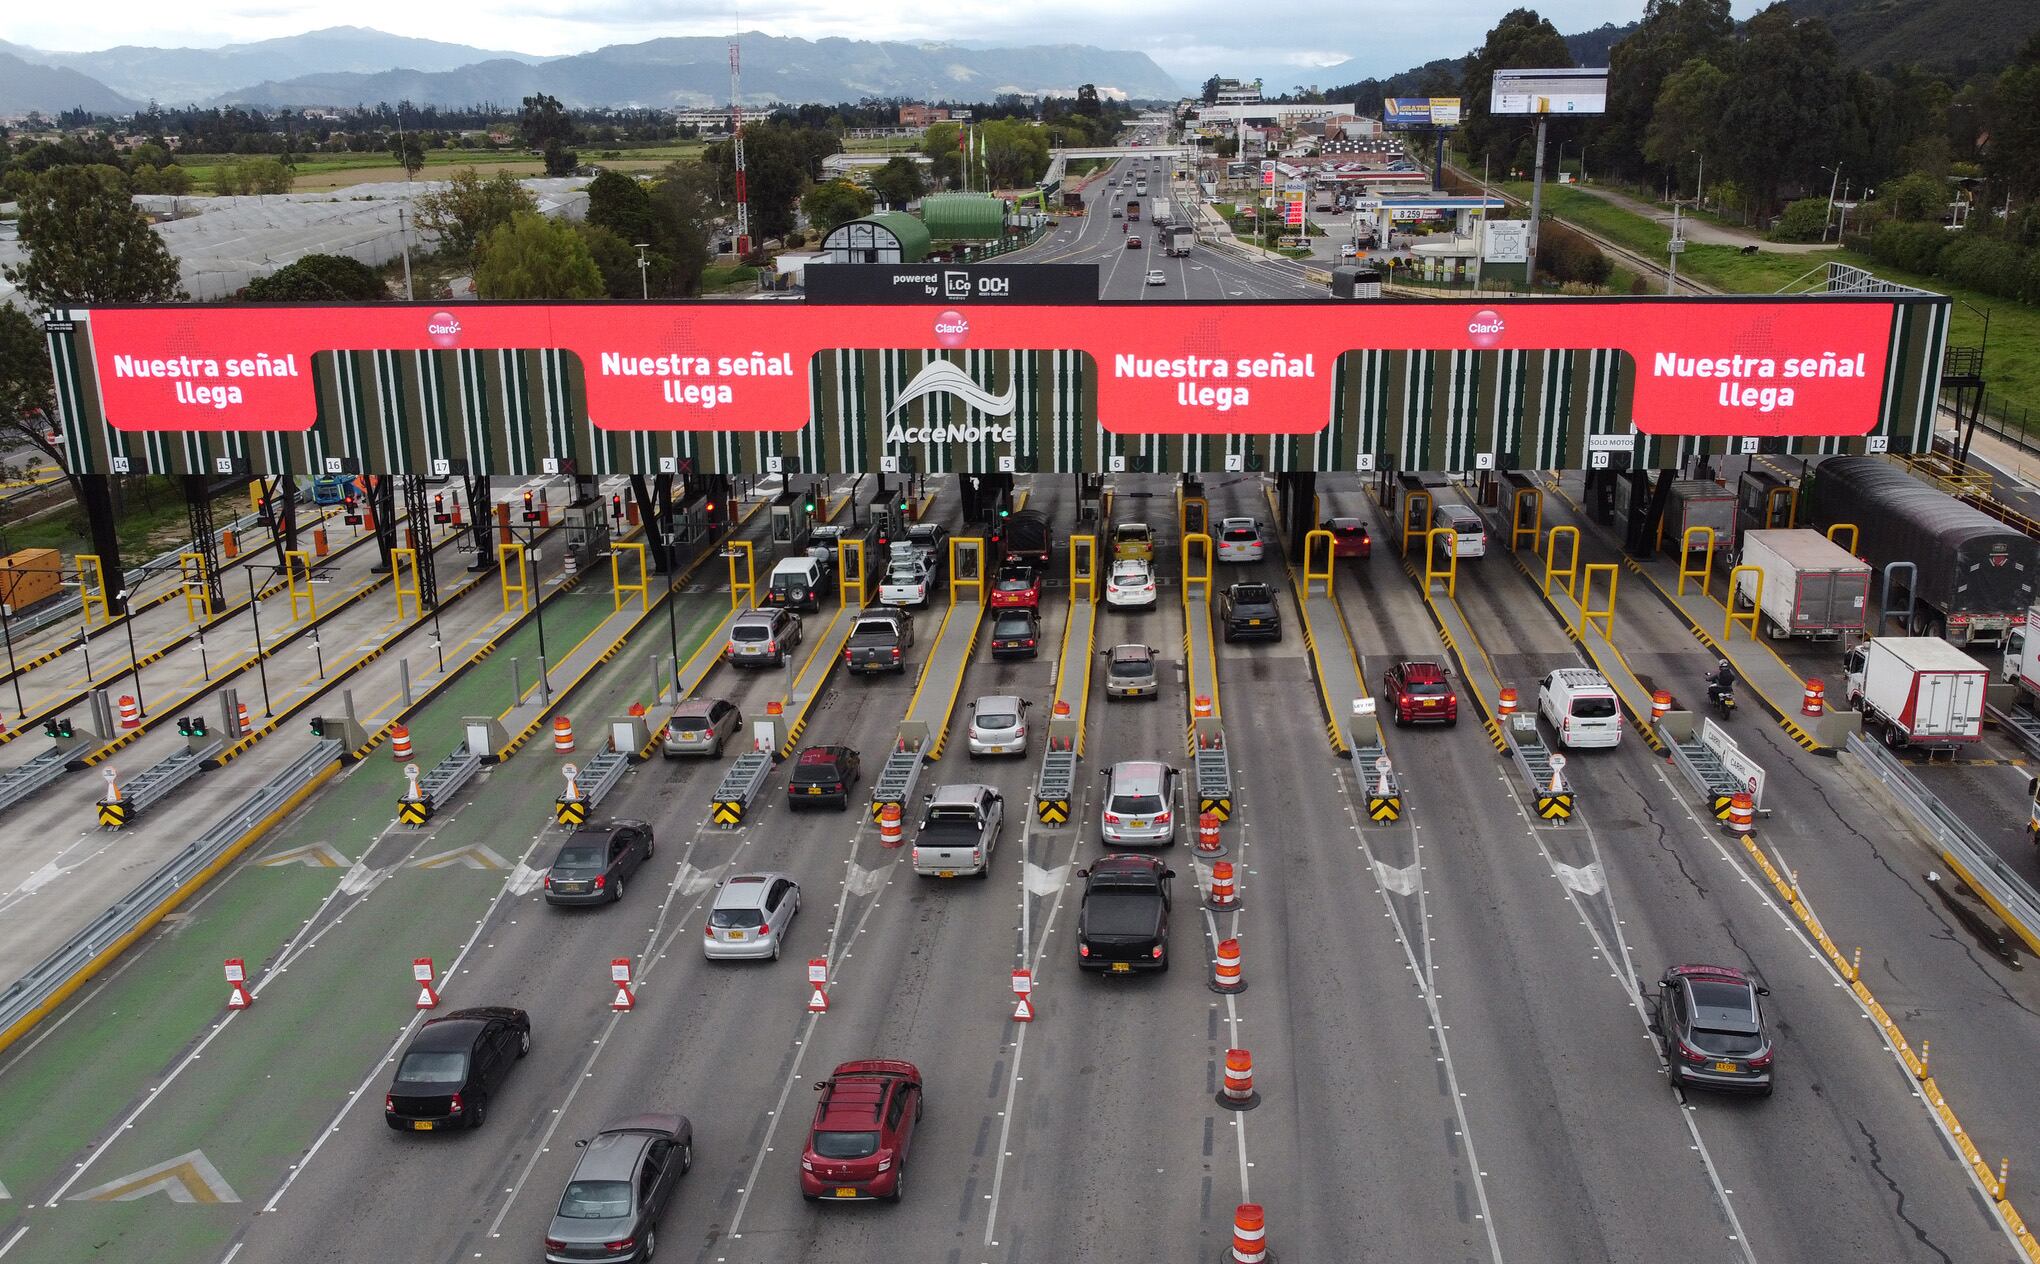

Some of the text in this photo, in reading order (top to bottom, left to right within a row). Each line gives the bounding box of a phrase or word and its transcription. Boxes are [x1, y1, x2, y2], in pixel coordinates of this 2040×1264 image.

[893, 273, 938, 286] powered
[925, 284, 938, 297] by
[429, 320, 460, 334] Claro
[935, 320, 967, 334] Claro
[1468, 319, 1503, 333] Claro
[114, 352, 299, 378] Nuestra señal
[602, 350, 793, 378] Nuestra señal
[1116, 351, 1315, 378] Nuestra señal
[1654, 351, 1866, 378] Nuestra señal
[175, 381, 243, 409] llega
[663, 379, 732, 409] llega
[1177, 381, 1249, 410] llega
[1718, 382, 1794, 413] llega
[887, 422, 1016, 445] AcceNorte
[1743, 440, 1756, 450] 11
[1872, 439, 1886, 450] 12
[115, 460, 128, 470] 14
[218, 460, 230, 470] 15
[664, 460, 671, 470] 2
[770, 459, 778, 469] 3
[884, 459, 892, 469] 4
[1003, 459, 1010, 469] 5
[1113, 459, 1121, 469] 6
[1229, 458, 1237, 467] 7
[1361, 457, 1369, 467] 8
[1481, 456, 1488, 466] 9
[1594, 455, 1607, 465] 10
[328, 461, 340, 470] 16
[436, 462, 448, 472] 17
[547, 461, 553, 471] 1
